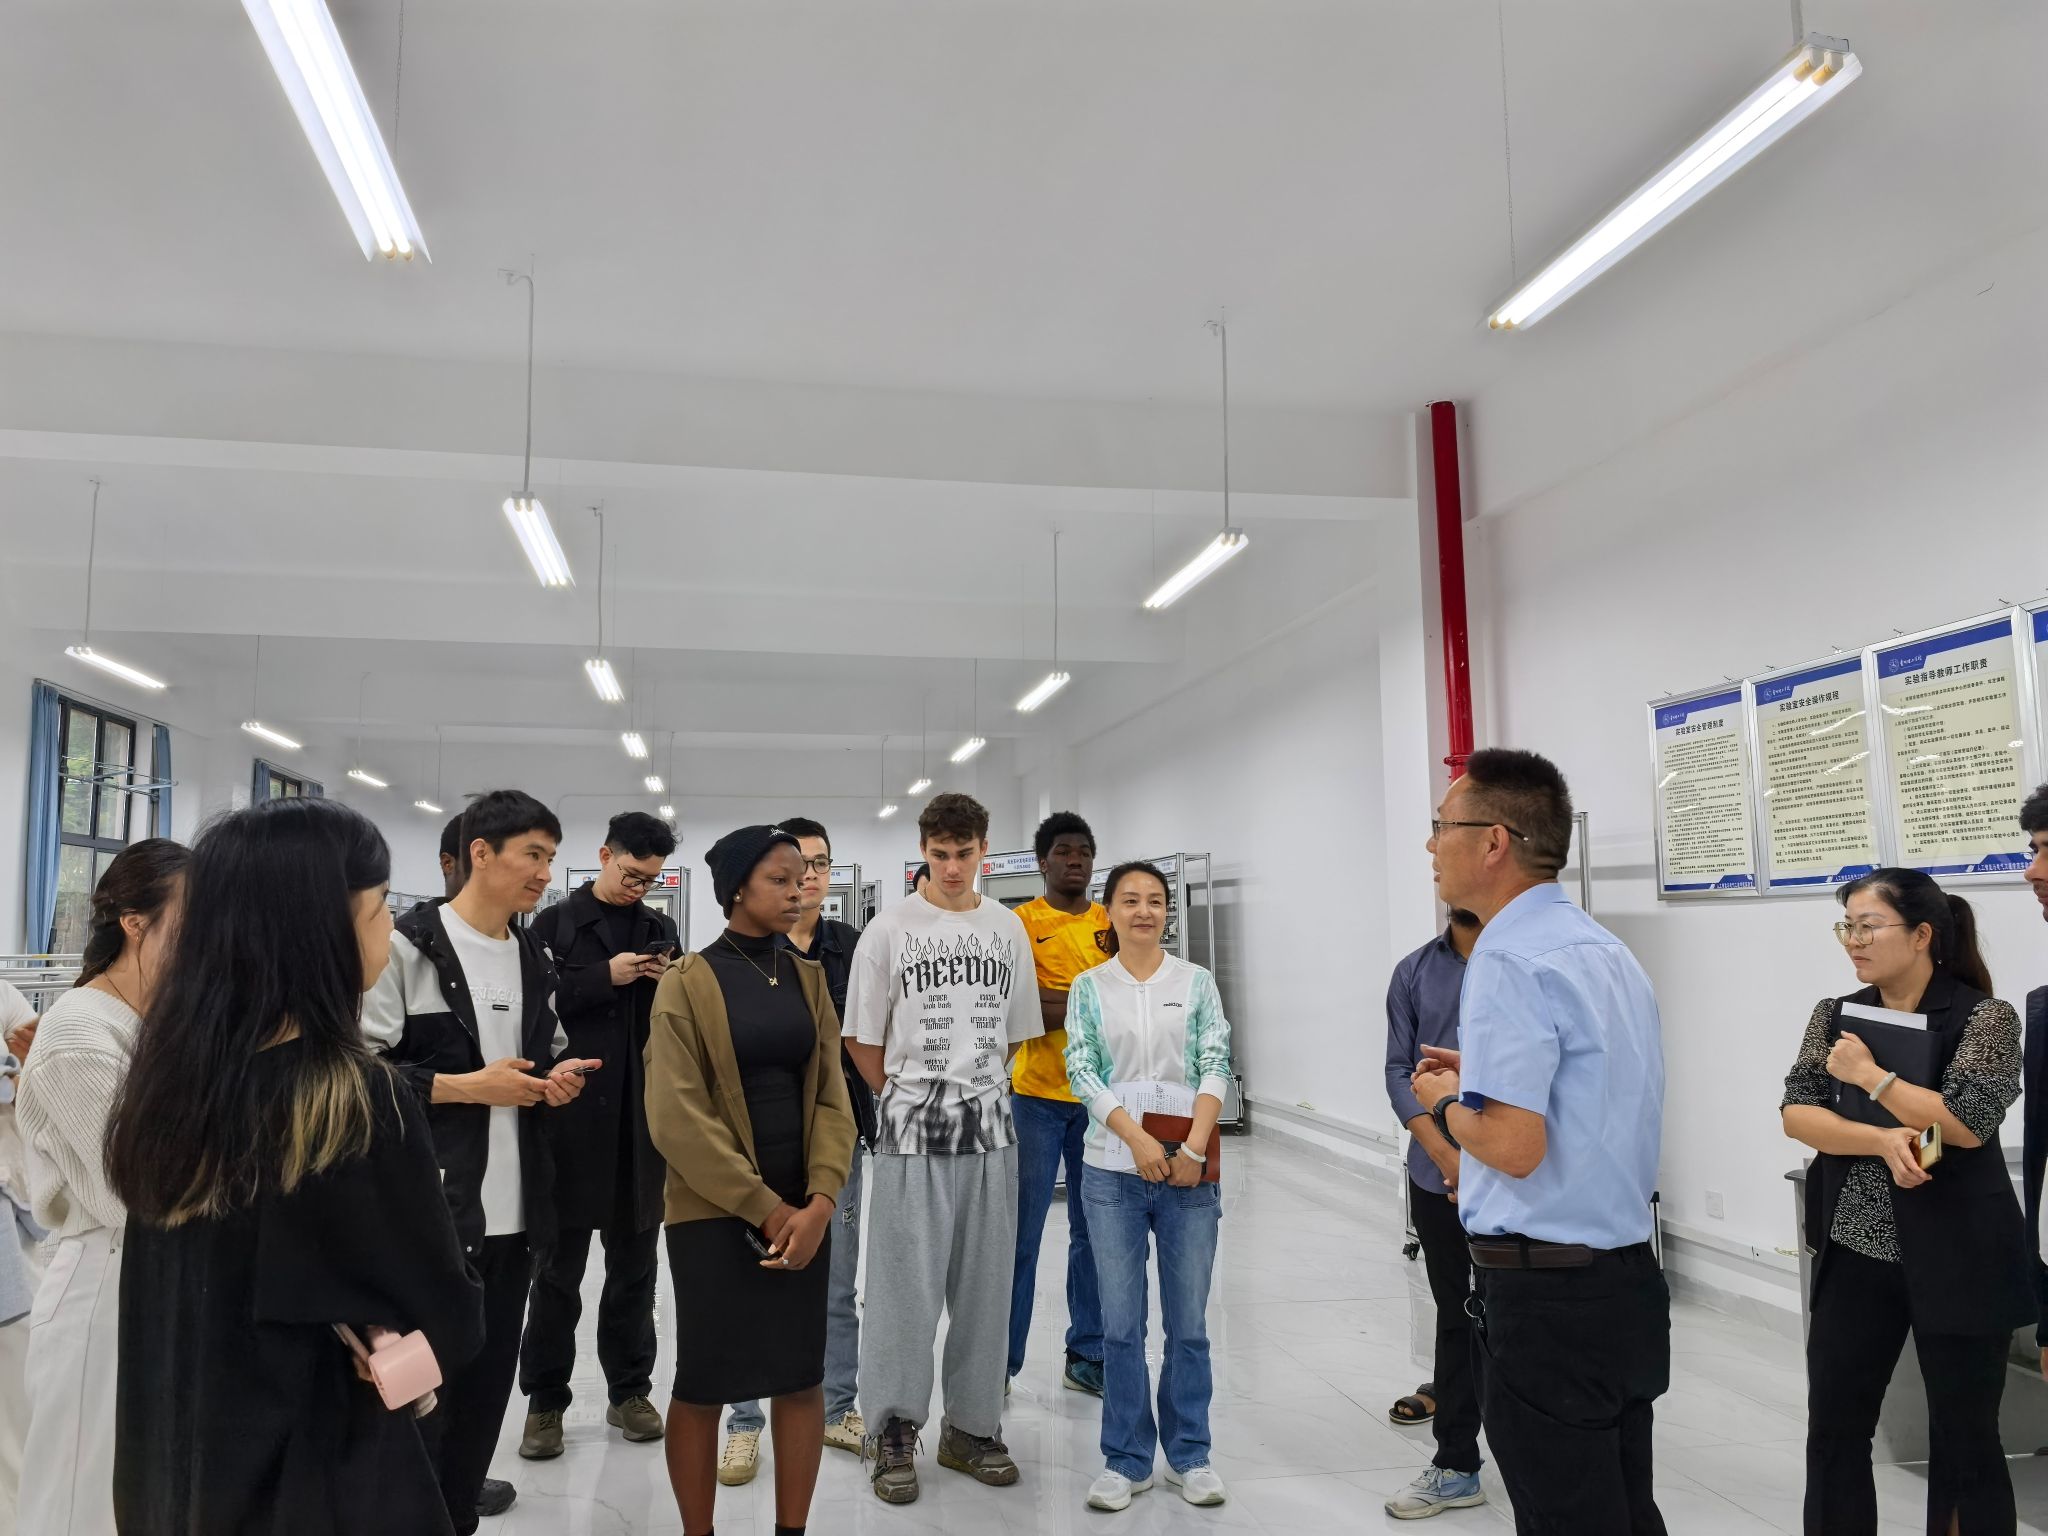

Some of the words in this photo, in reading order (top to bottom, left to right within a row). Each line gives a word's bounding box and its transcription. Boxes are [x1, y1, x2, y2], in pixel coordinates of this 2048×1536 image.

[1904, 658, 1988, 685] 实验指导教师工作职责
[1779, 690, 1840, 712] 实验室安全操作规程
[1675, 719, 1724, 736] 实验室安全管理制度
[901, 955, 1012, 999] FREEDOM
